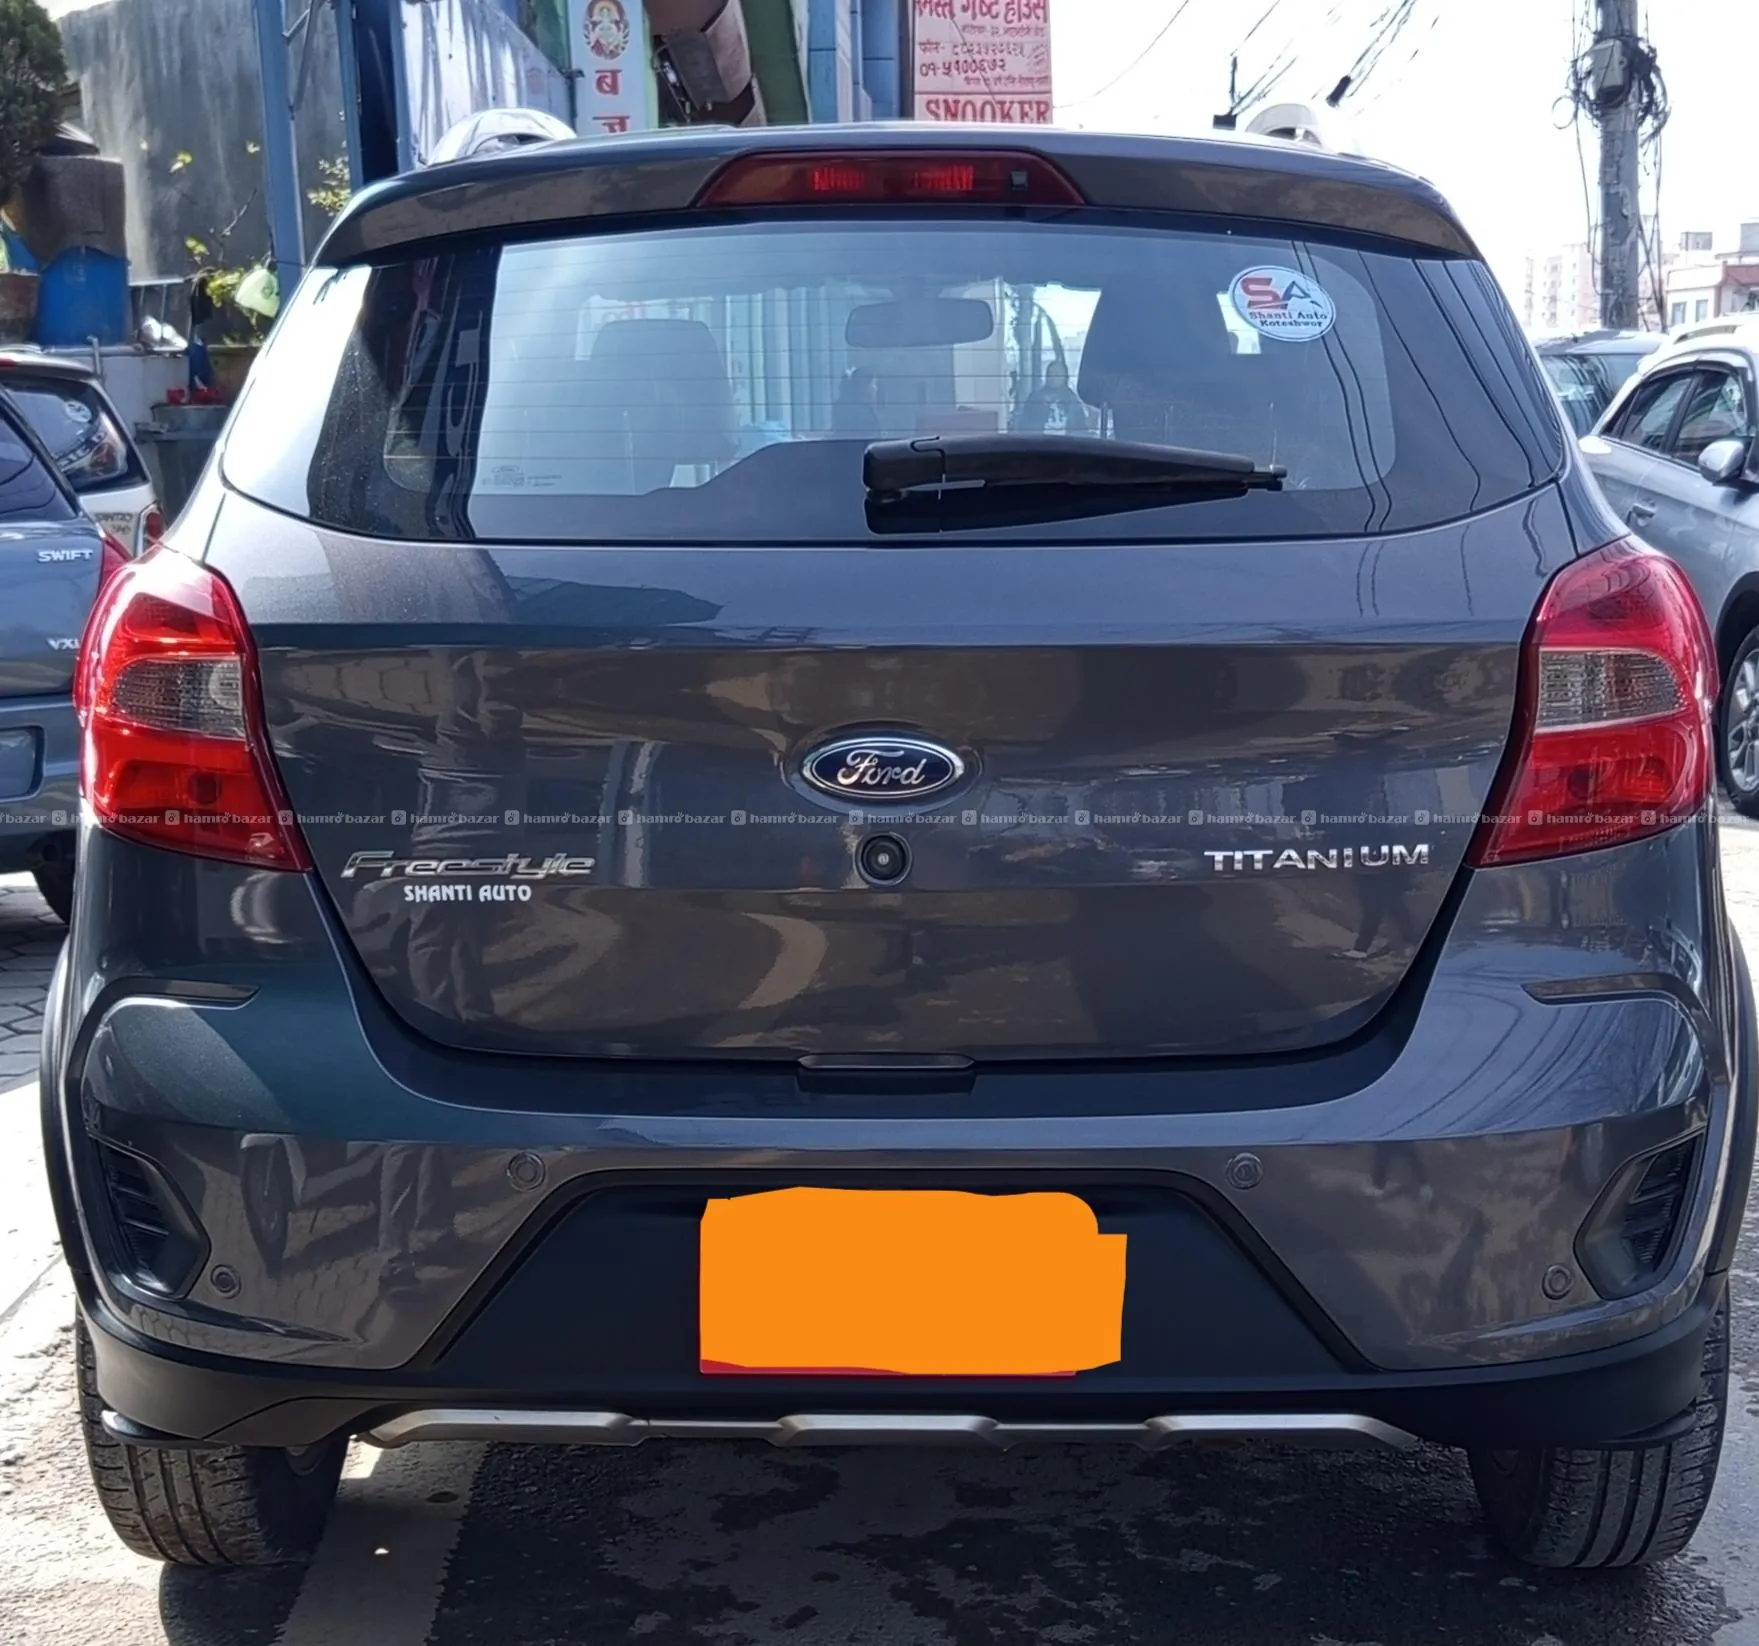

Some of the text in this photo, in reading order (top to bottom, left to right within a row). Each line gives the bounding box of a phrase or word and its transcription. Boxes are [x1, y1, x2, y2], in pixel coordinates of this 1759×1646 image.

[925, 99, 1050, 123] SNOOKER
[1248, 311, 1328, 320] Shanti Auto
[1260, 319, 1323, 328] Koteshwor
[37, 549, 93, 562] SWIFT
[836, 749, 928, 786] Ford
[340, 850, 595, 880] Freestyle
[1204, 843, 1430, 871] TITANIUM
[403, 884, 532, 902] SHANTI AUTO
